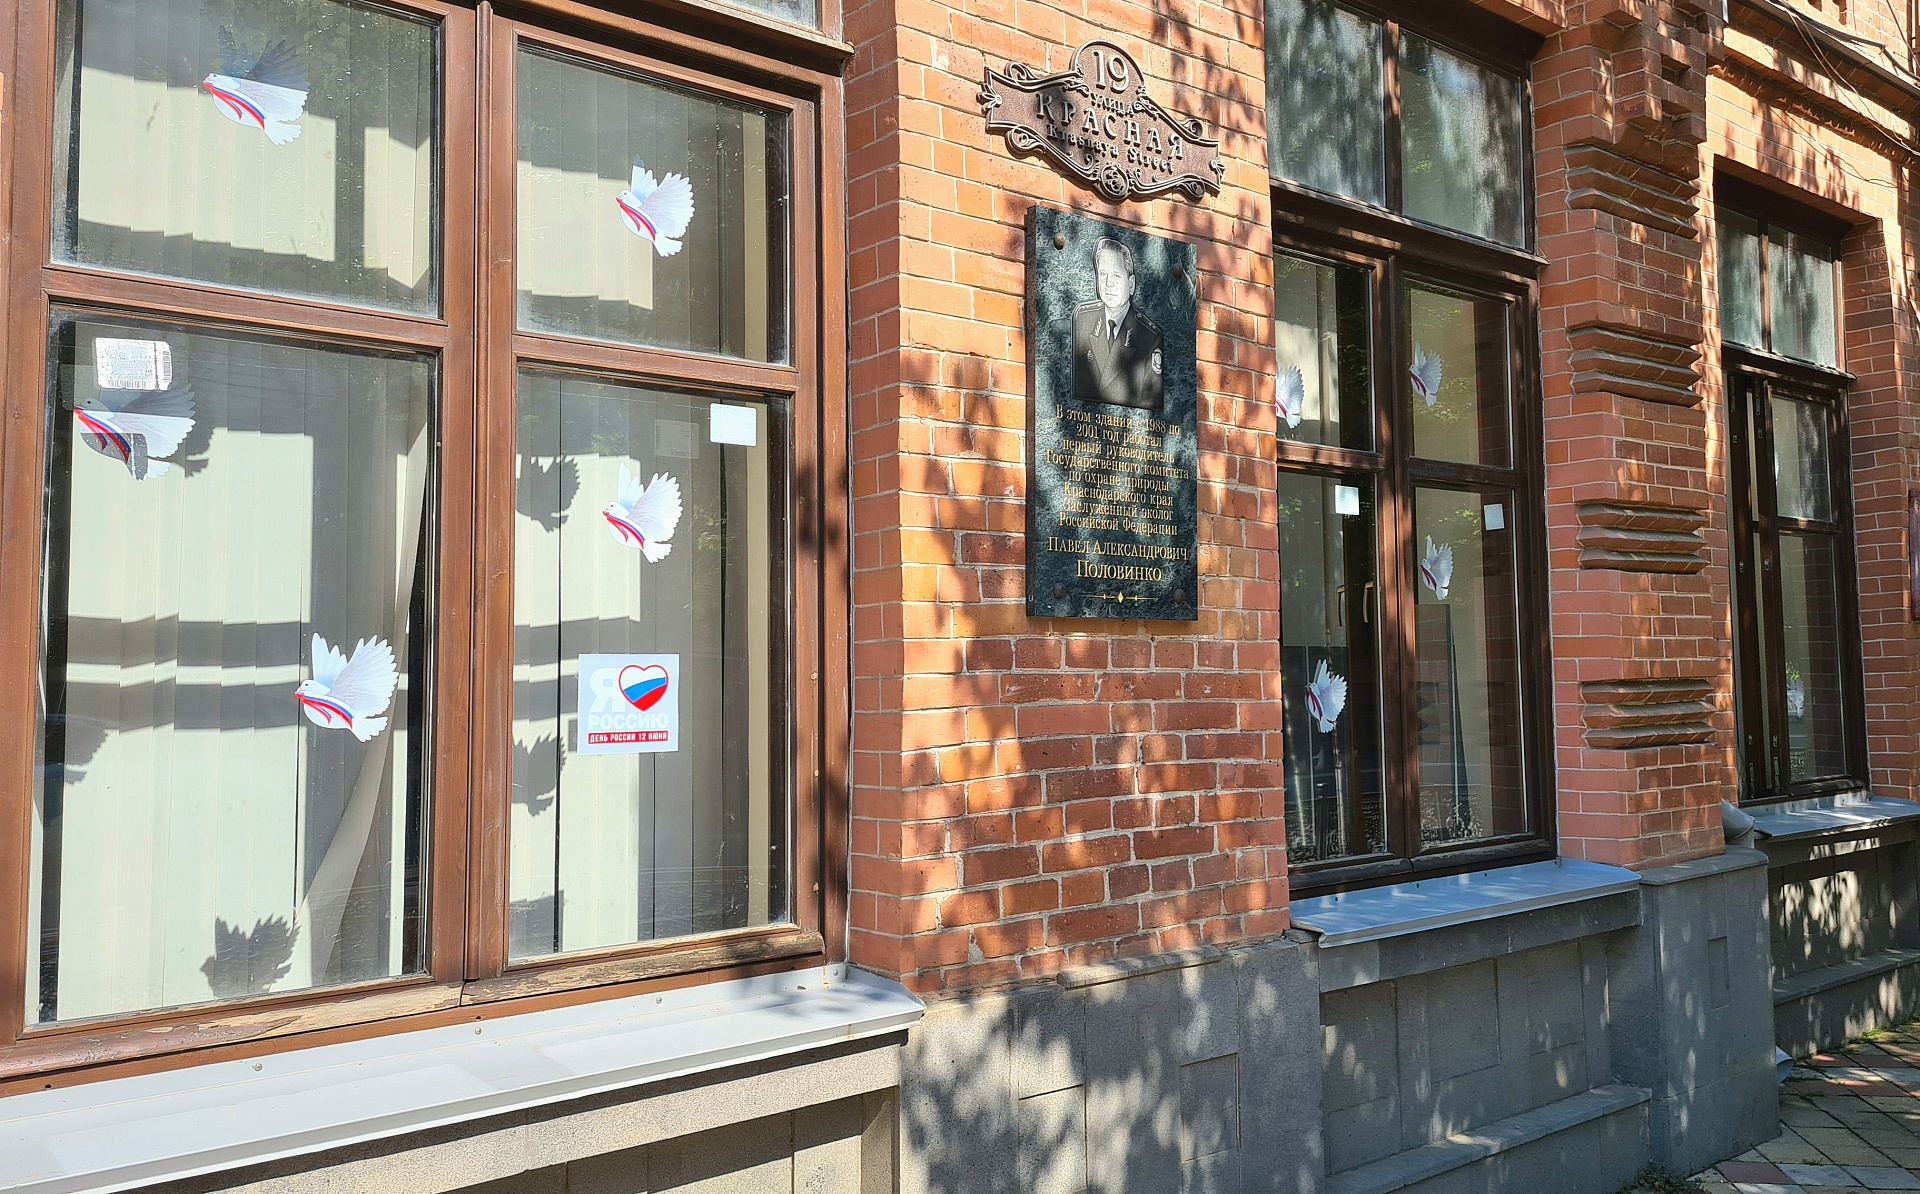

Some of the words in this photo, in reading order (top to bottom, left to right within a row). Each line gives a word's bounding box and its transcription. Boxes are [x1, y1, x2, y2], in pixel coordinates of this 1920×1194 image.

[1093, 50, 1130, 93] 19
[1091, 93, 1135, 117] УЛИЦА
[1036, 92, 1184, 160] КРАСНАЯ
[1047, 124, 1119, 157] Krasnaya
[1128, 147, 1176, 173] Street
[1056, 404, 1063, 419] В
[1066, 408, 1091, 422] этом
[1095, 412, 1133, 429] здании
[1136, 418, 1141, 430] с
[1145, 418, 1167, 434] 1988
[1169, 424, 1181, 436] по
[1076, 423, 1099, 439] 2001
[1102, 429, 1120, 443] год
[1123, 432, 1162, 448] работал
[1063, 439, 1101, 454] первый
[1106, 444, 1175, 463] руководитель
[1045, 449, 1140, 473] Государственного
[1144, 464, 1189, 480] комитета
[1068, 471, 1081, 482] по
[1085, 473, 1121, 487] охране
[1125, 477, 1170, 492] природы
[1064, 482, 1146, 504] Краснодарского
[1150, 492, 1174, 507] края
[1063, 499, 1138, 518] Заслуженный
[1141, 507, 1174, 521] эколог
[1059, 512, 1119, 531] Российской
[1122, 518, 1178, 536] Федерации
[1048, 536, 1090, 554] ПАВЕЛ
[1093, 539, 1189, 560] АЛЕКСАНДРОВИЧ
[1076, 560, 1162, 582] ПОЛОВИНКО
[589, 668, 626, 712] Я
[588, 713, 669, 731] РОССИЮ
[590, 734, 608, 743] ДЕНЬ
[610, 733, 636, 742] РОССИИ
[639, 733, 646, 741] 12
[648, 732, 667, 740] ИЮНЯ
